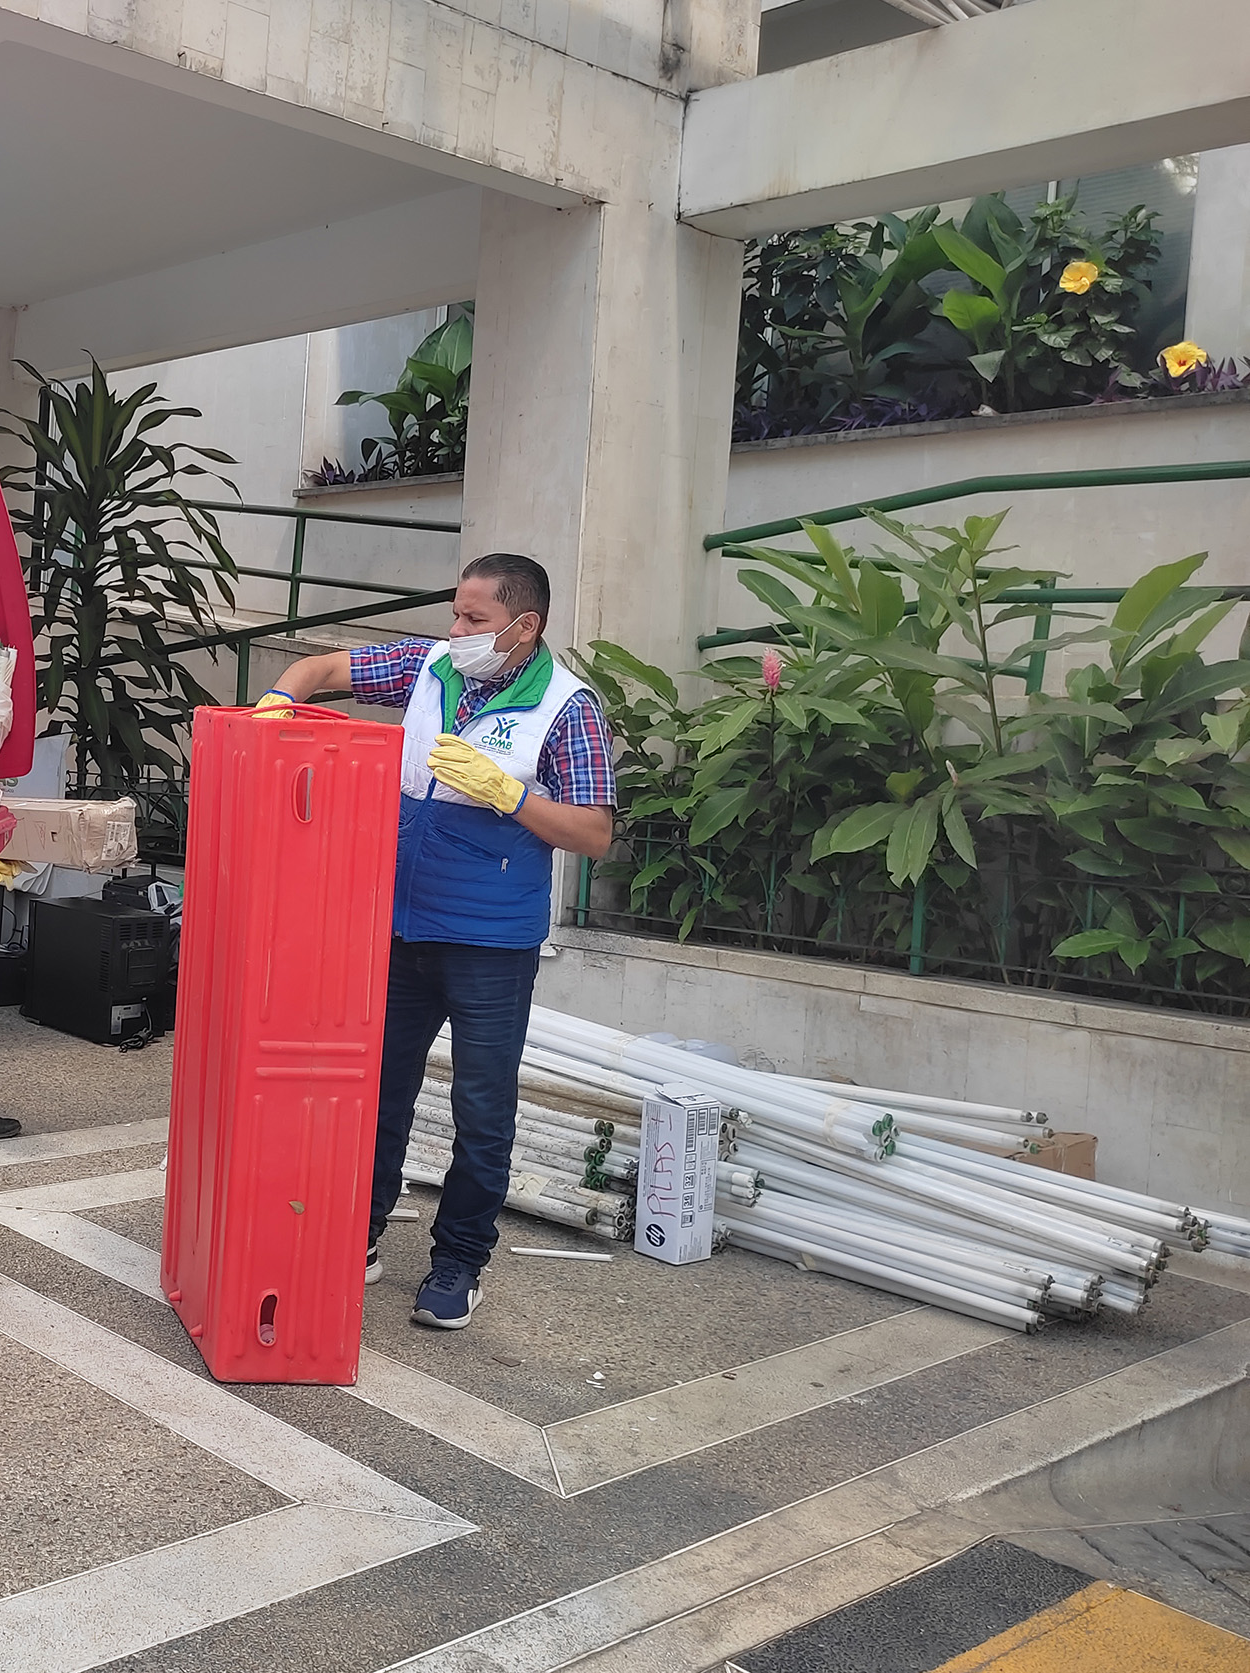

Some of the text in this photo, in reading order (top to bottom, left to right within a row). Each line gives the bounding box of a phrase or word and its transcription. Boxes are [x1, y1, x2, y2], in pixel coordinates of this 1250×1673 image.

[481, 735, 513, 750] CDMB
[646, 1142, 680, 1219] PILAS
[645, 1223, 666, 1248] hp
